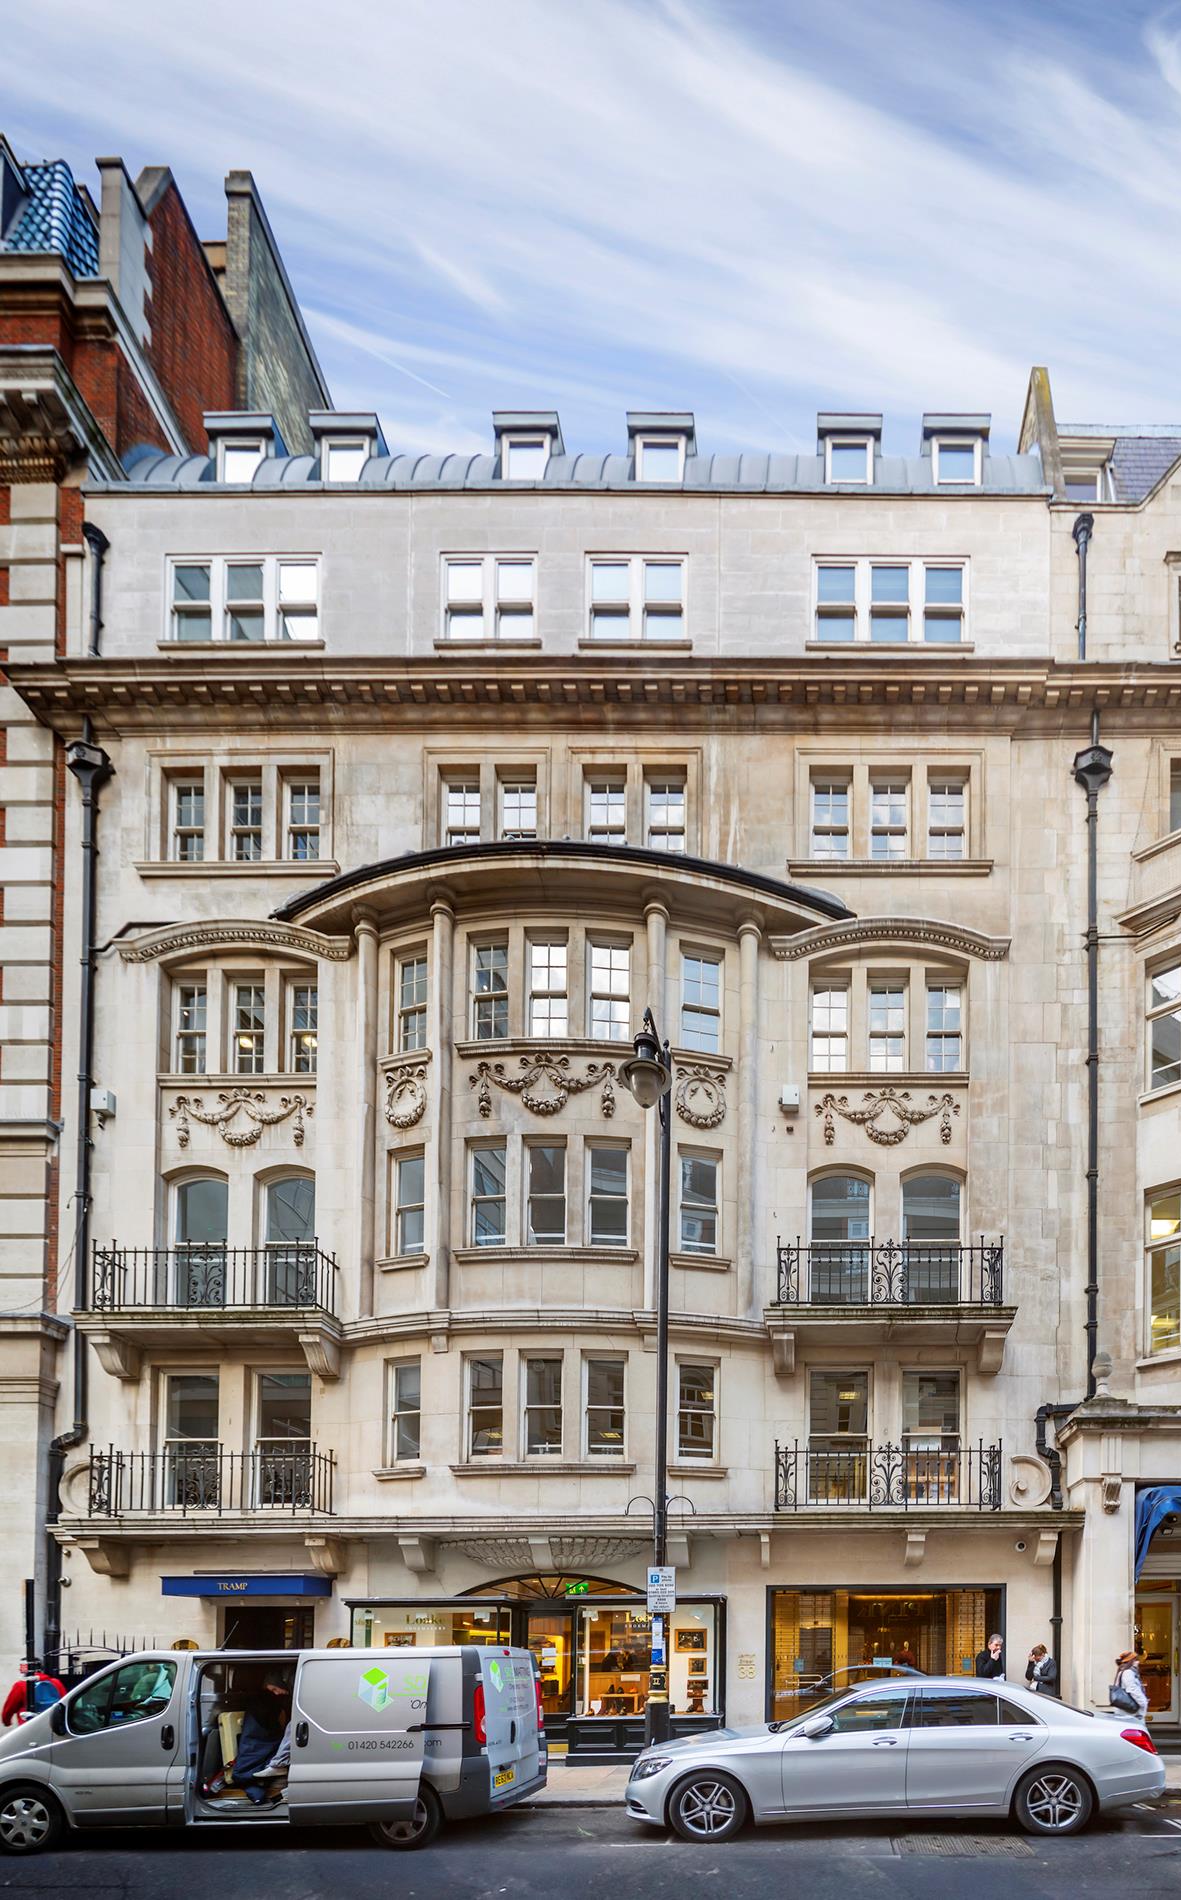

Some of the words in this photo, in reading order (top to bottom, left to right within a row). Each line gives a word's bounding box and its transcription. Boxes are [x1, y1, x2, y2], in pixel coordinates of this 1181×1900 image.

[217, 1582, 248, 1591] TRAMP
[348, 1741, 377, 1751] 01420
[380, 1740, 414, 1750] 542266
